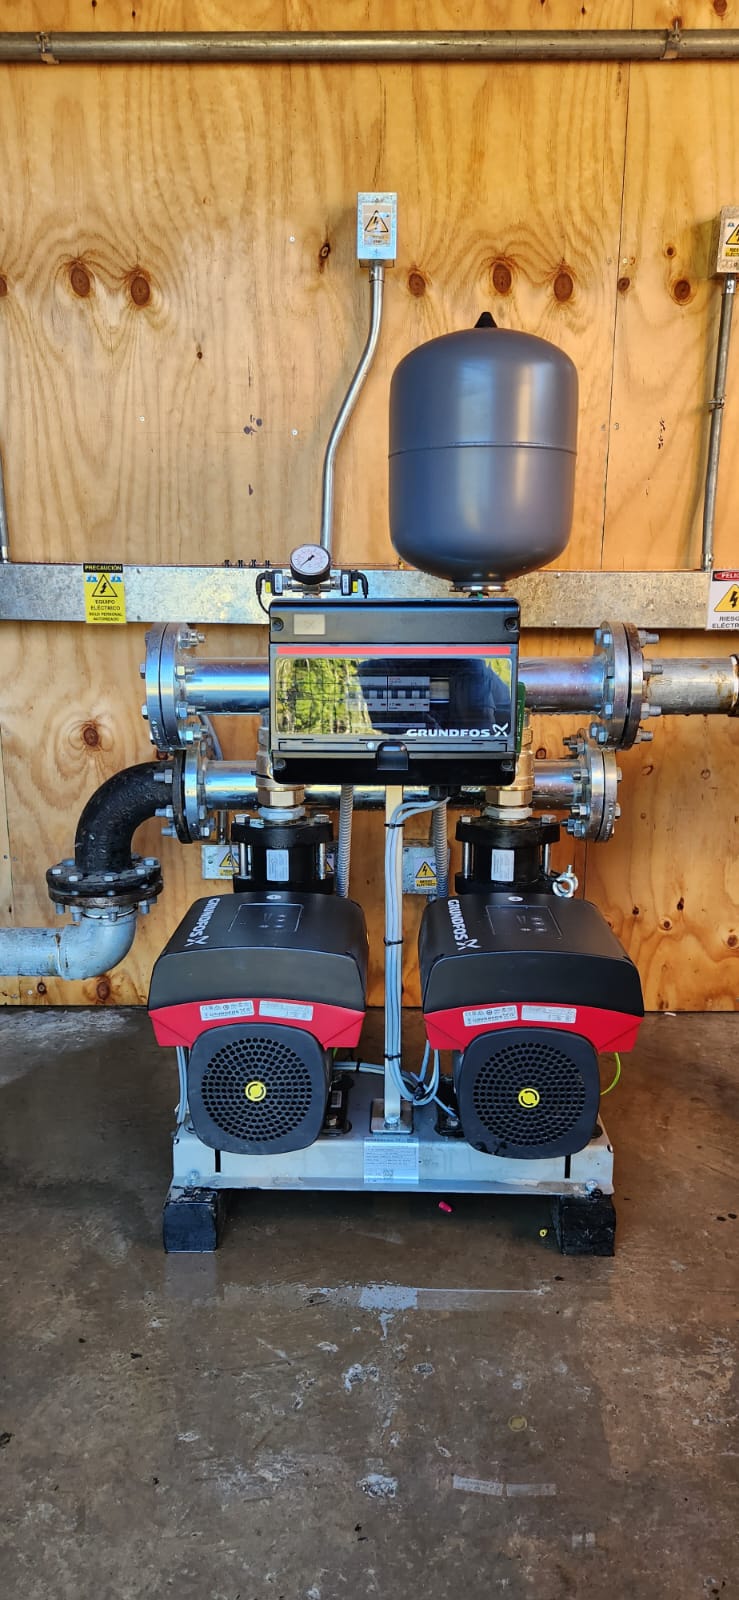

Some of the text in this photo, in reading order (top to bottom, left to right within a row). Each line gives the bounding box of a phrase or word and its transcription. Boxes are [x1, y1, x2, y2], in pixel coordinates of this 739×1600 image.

[406, 728, 490, 737] GRUNDFOS
[189, 897, 221, 938] GRUNDFOS
[447, 899, 469, 941] GRUNDFOS
